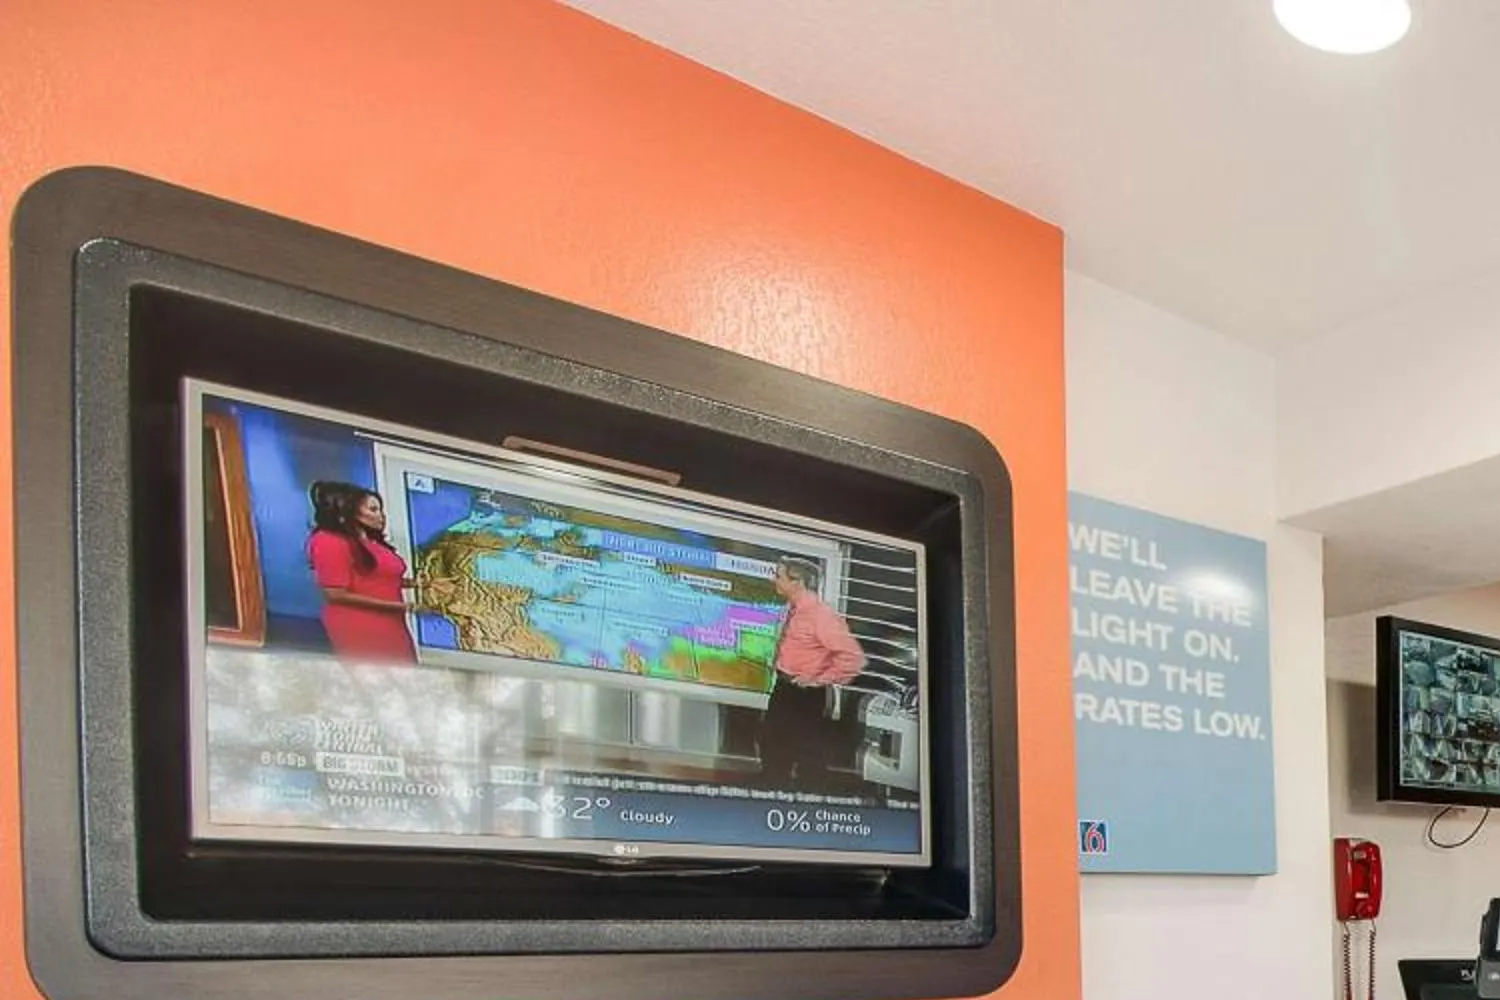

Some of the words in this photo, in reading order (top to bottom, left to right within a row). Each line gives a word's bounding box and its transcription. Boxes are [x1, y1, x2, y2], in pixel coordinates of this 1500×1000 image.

[1068, 522, 1167, 570] WE'LL
[1071, 565, 1178, 614] LEAVE
[1188, 589, 1251, 627] THE
[1072, 607, 1174, 651] LIGHT
[1184, 629, 1240, 663] ON.
[1074, 651, 1149, 686] AND
[1159, 664, 1226, 698] THE
[1075, 692, 1183, 732] RATES
[1194, 709, 1266, 741] LOW.
[766, 808, 811, 833] 0%
[815, 810, 861, 823] Chance
[815, 822, 829, 833] of
[831, 823, 871, 836] Precip
